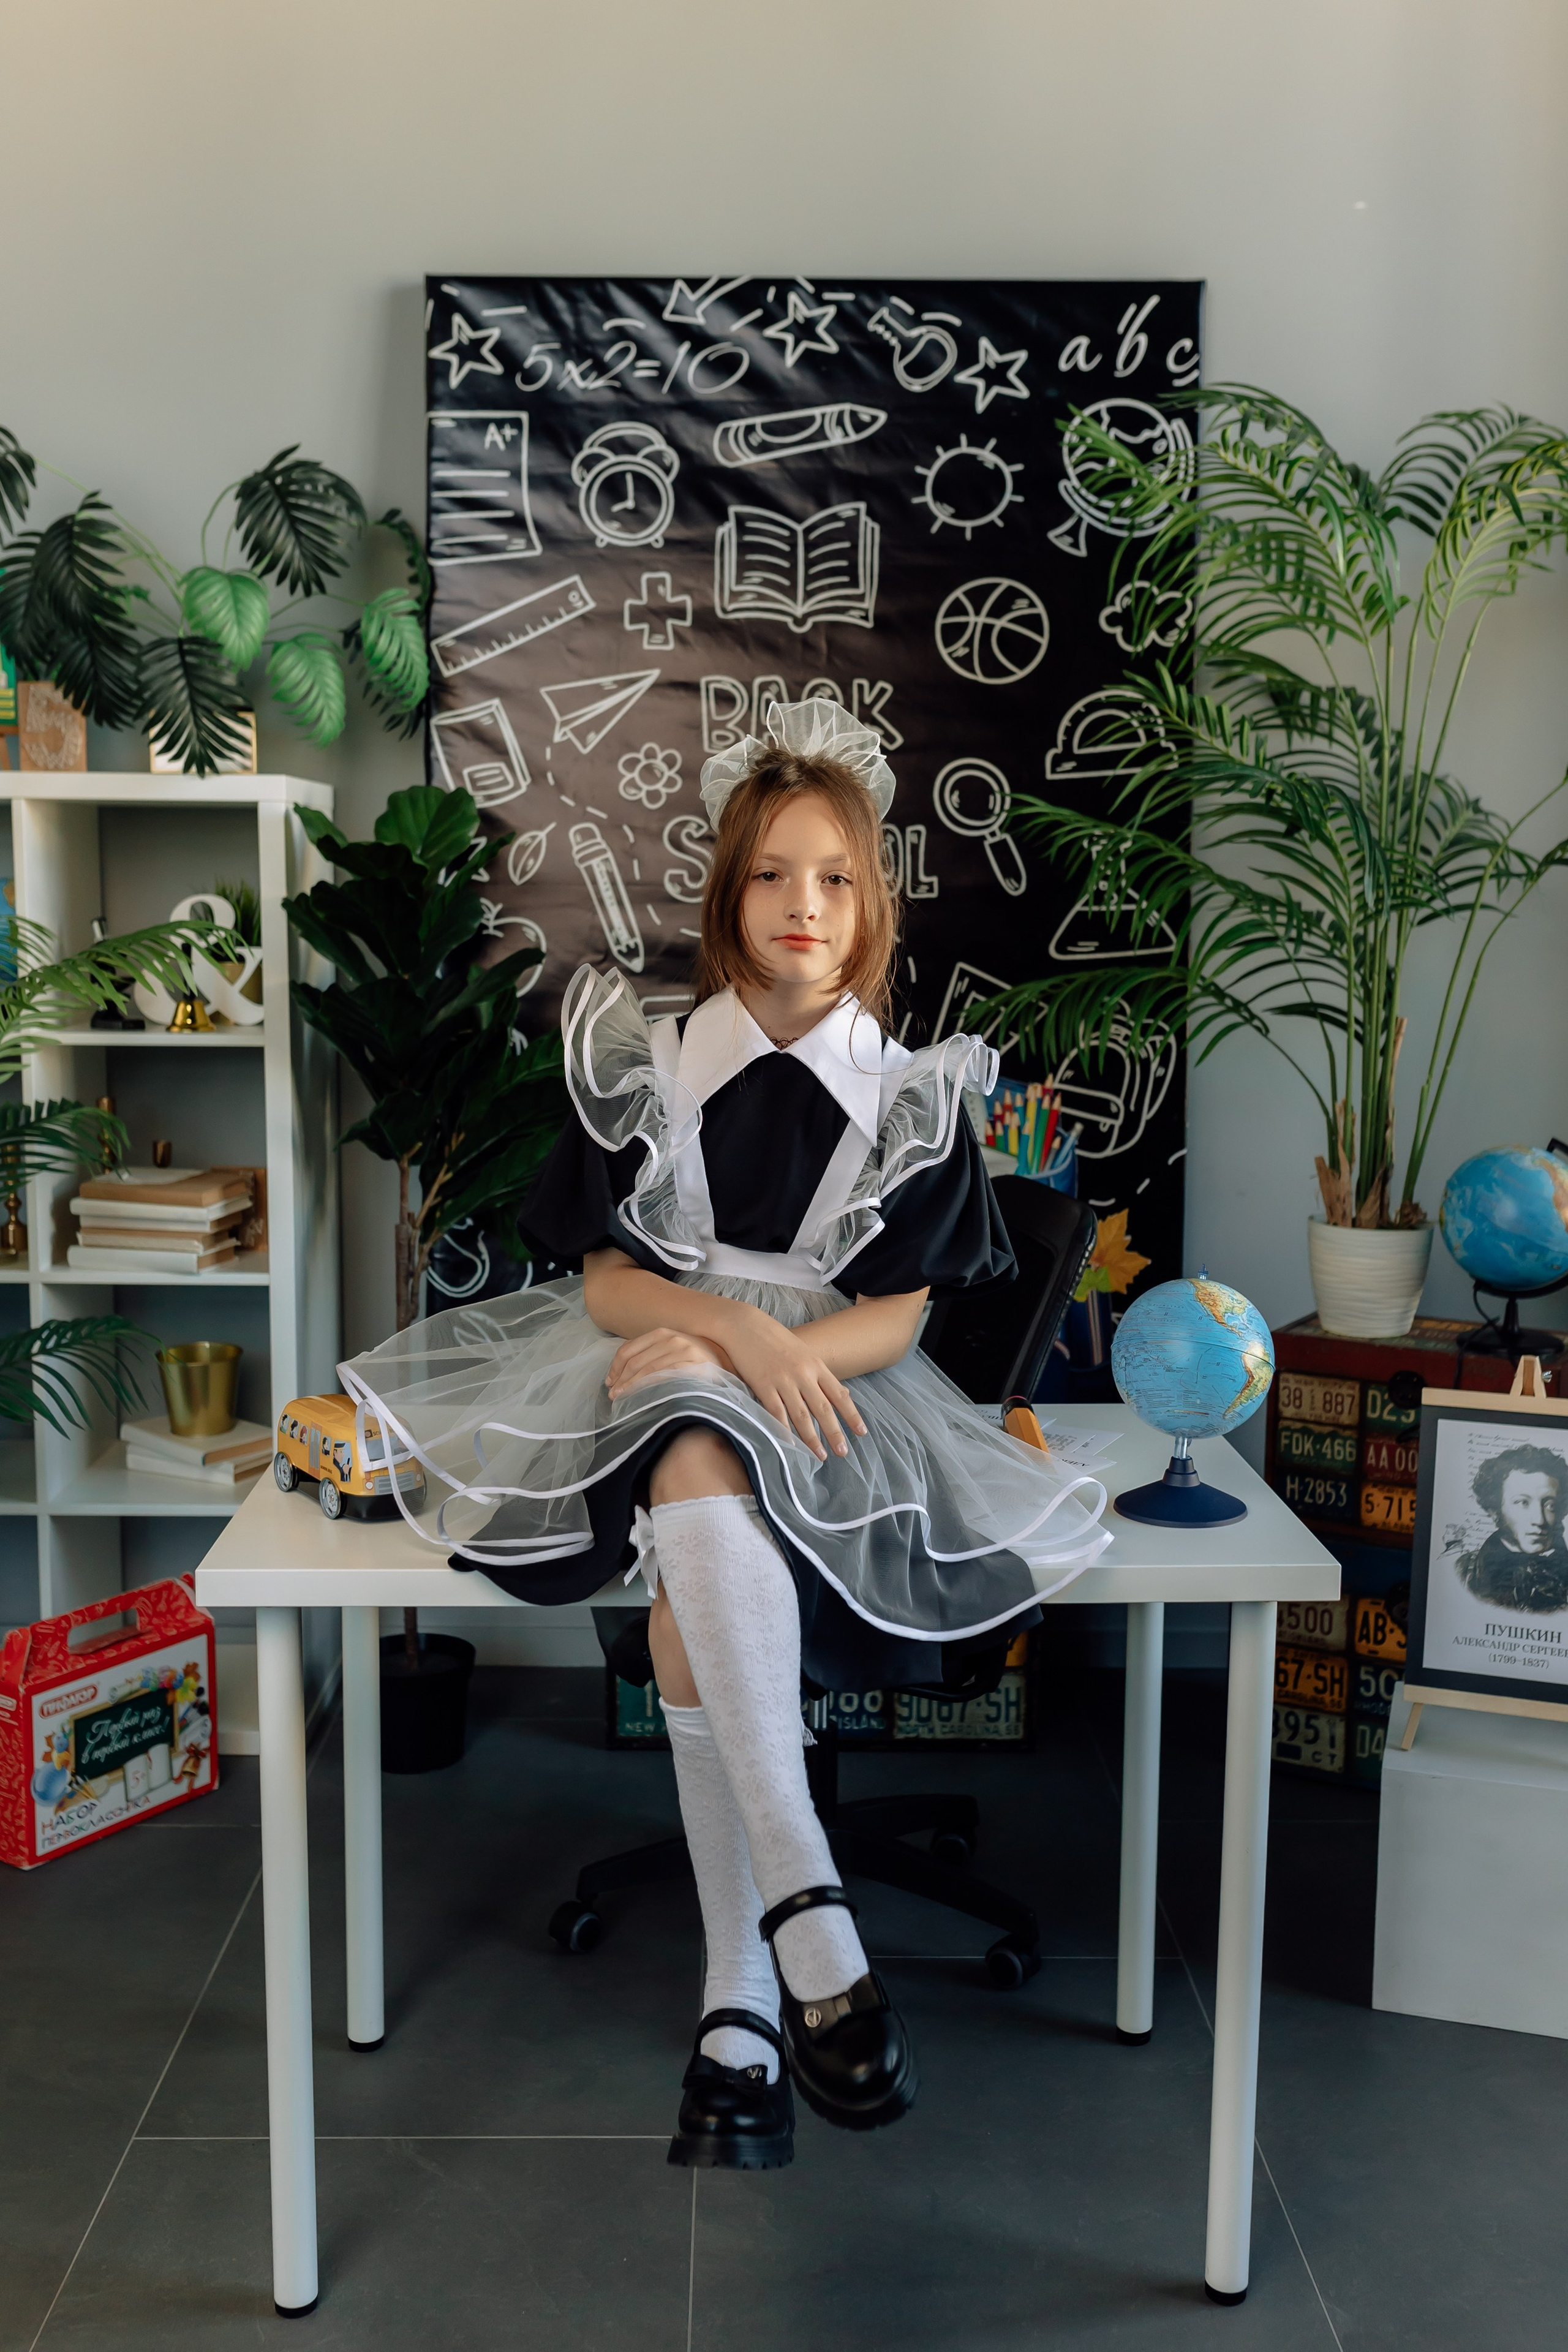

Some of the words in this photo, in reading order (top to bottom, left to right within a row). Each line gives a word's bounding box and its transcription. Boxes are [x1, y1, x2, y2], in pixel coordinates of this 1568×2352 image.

[484, 423, 518, 451] A+
[1281, 1386, 1303, 1409] 38
[1323, 1391, 1355, 1415] 887
[1452, 1635, 1520, 1653] АЛЕКСАНДР
[1485, 1623, 1562, 1644] ПУШКИН
[829, 1690, 883, 1713] 00
[42, 1801, 98, 1835] НАБОР
